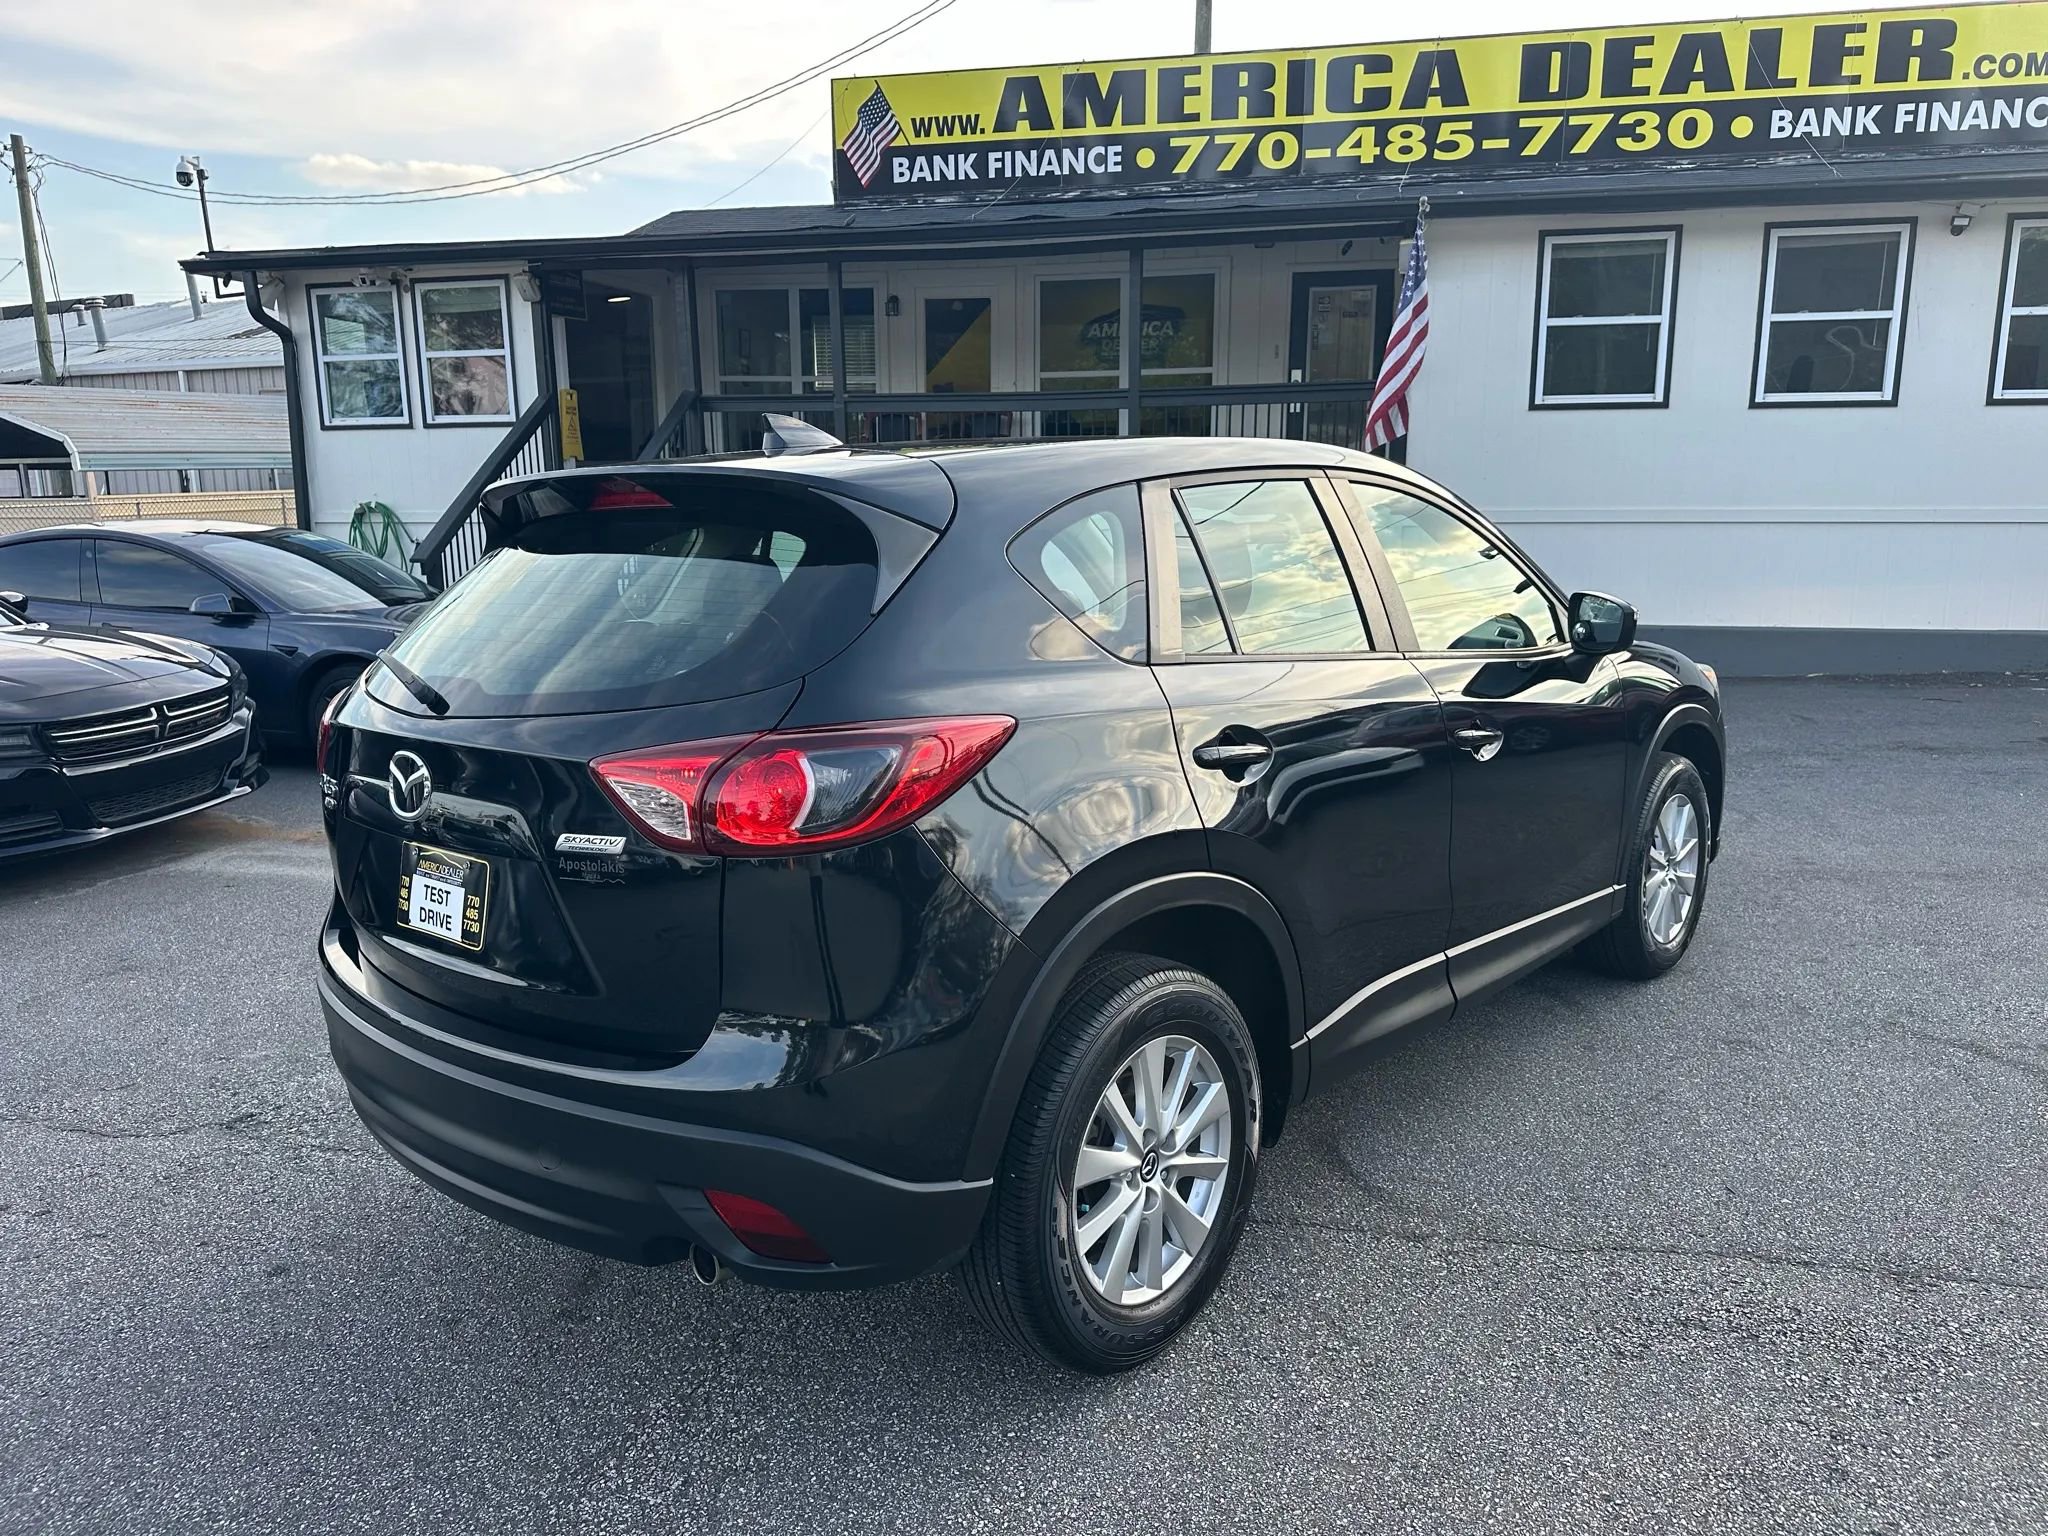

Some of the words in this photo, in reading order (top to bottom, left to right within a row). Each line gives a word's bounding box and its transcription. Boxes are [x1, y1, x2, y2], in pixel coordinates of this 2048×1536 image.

[992, 49, 1470, 133] AMERICA
[1518, 18, 1957, 104] DEALER
[892, 152, 979, 184] BANK
[987, 145, 1122, 179] FINANCE
[1169, 108, 1714, 174] 770-485-7730
[1769, 104, 1883, 139] BANK
[1088, 320, 1174, 338] AMICA
[563, 835, 618, 846] SKYACTIV
[560, 857, 625, 874] Apostolakis
[424, 884, 451, 907] TEST
[467, 895, 480, 909] 770
[419, 906, 452, 932] DRIVE
[465, 907, 479, 921] 485
[463, 919, 480, 934] 7730
